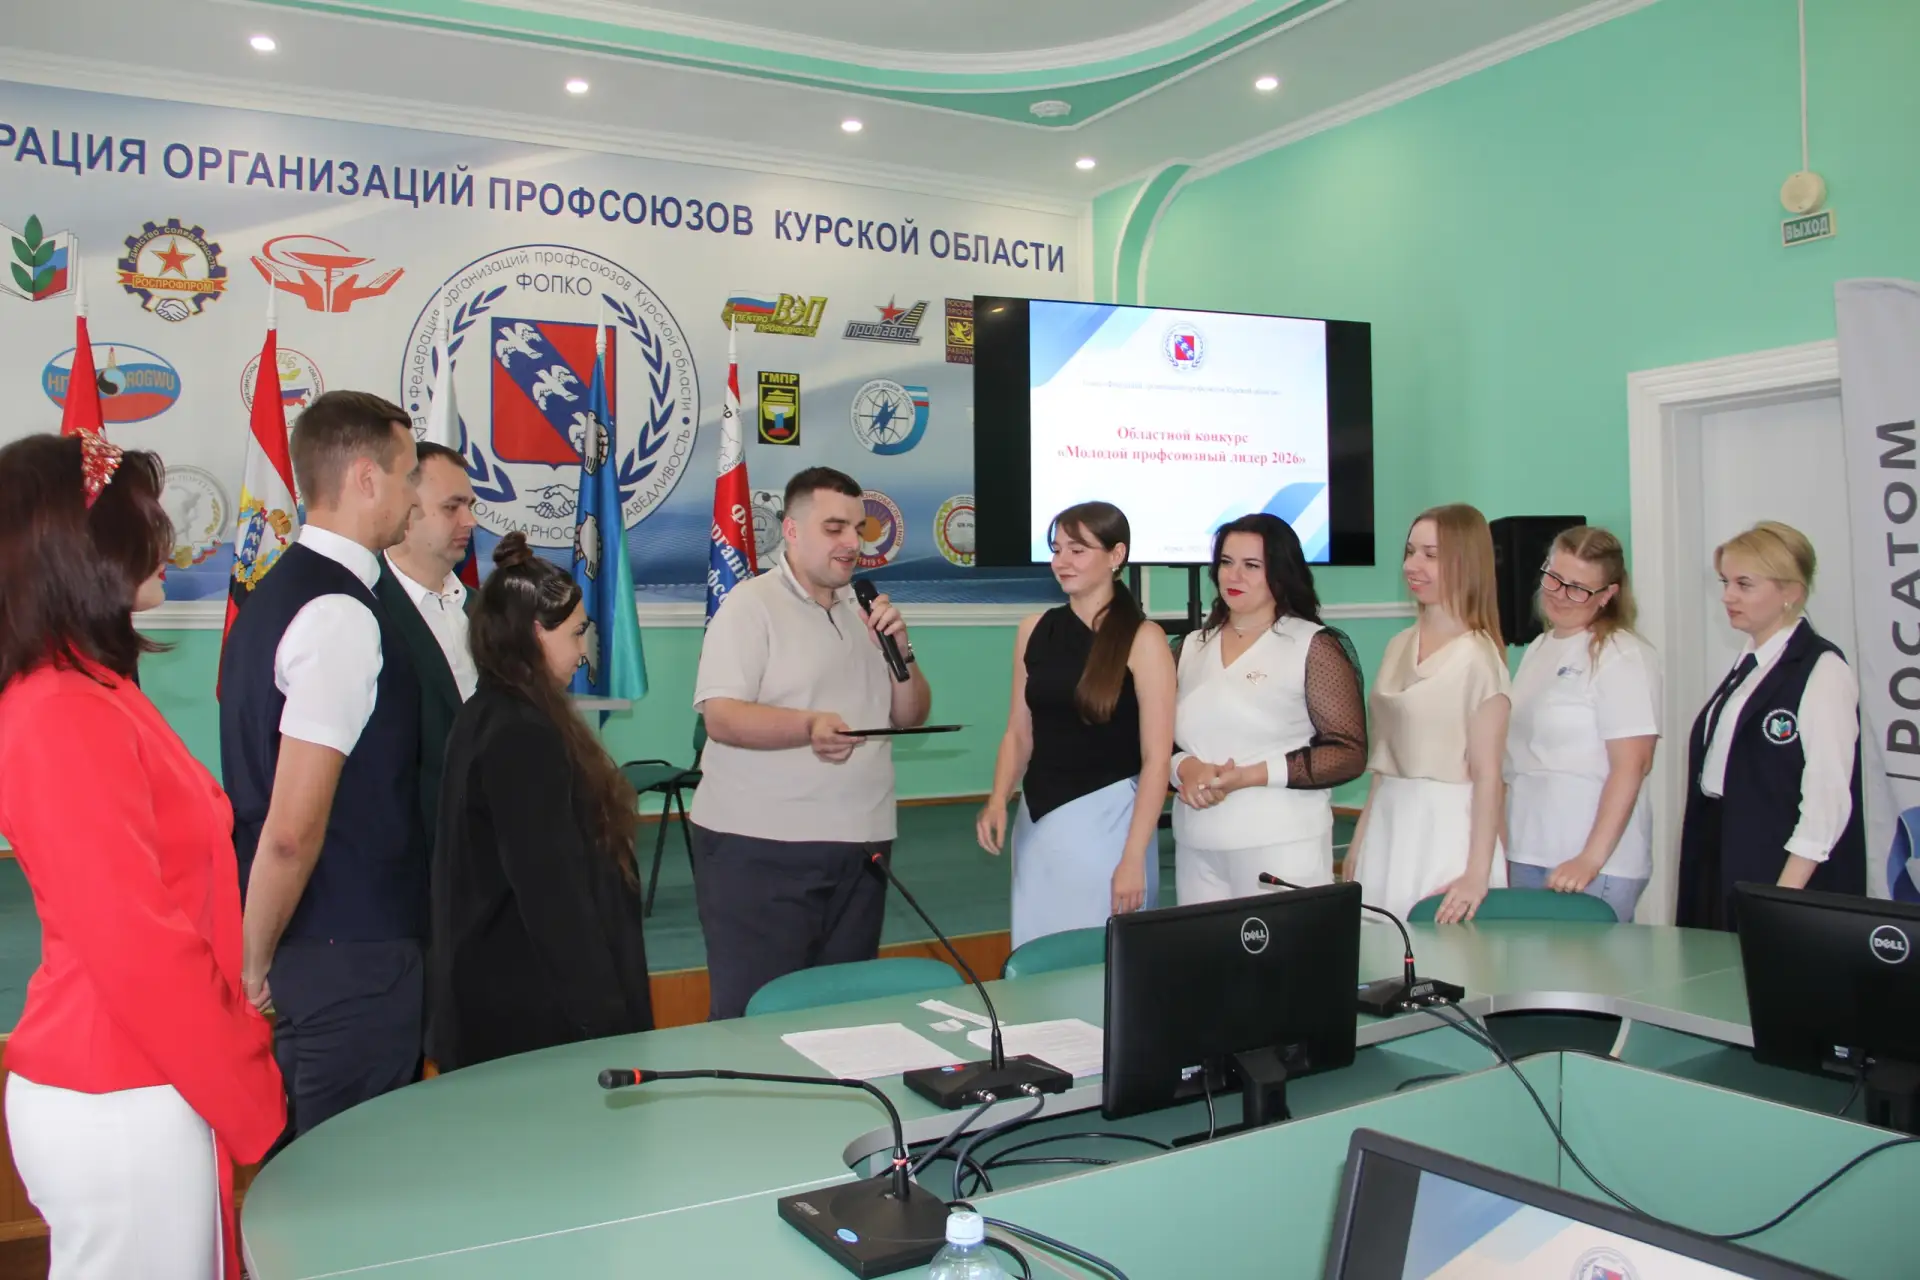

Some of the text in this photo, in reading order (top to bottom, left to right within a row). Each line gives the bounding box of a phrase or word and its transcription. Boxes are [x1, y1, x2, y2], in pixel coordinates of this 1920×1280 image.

[163, 143, 475, 208] ОРГАНИЗАЦИЙ
[488, 176, 753, 236] ПРОФСОЮЗОВ
[774, 209, 919, 256] КУРСКОЙ
[930, 229, 1065, 274] ОБЛАСТИ
[1785, 216, 1829, 241] ВЫХОД
[128, 227, 217, 271] ЕДИНСТВО СОЛИДАРНОСТЬ
[135, 277, 213, 291] РОСПРОФПРОМ
[516, 272, 592, 296] ФОПКО
[535, 251, 632, 291] профсоюзов
[634, 289, 679, 346] Курской
[672, 348, 692, 411] области
[760, 372, 798, 384] ГМПР
[1117, 426, 1249, 448] Областной конкурс
[1057, 445, 1306, 467] «Молодой профсоюзный лидер 2026»
[625, 429, 691, 521] АВЕДЛИВОСТЬ
[474, 502, 576, 540] ОЛИДАРНОС
[1876, 419, 1920, 755] РОСАТОМ
[1244, 930, 1266, 941] DELL
[1873, 937, 1905, 951] DELL
